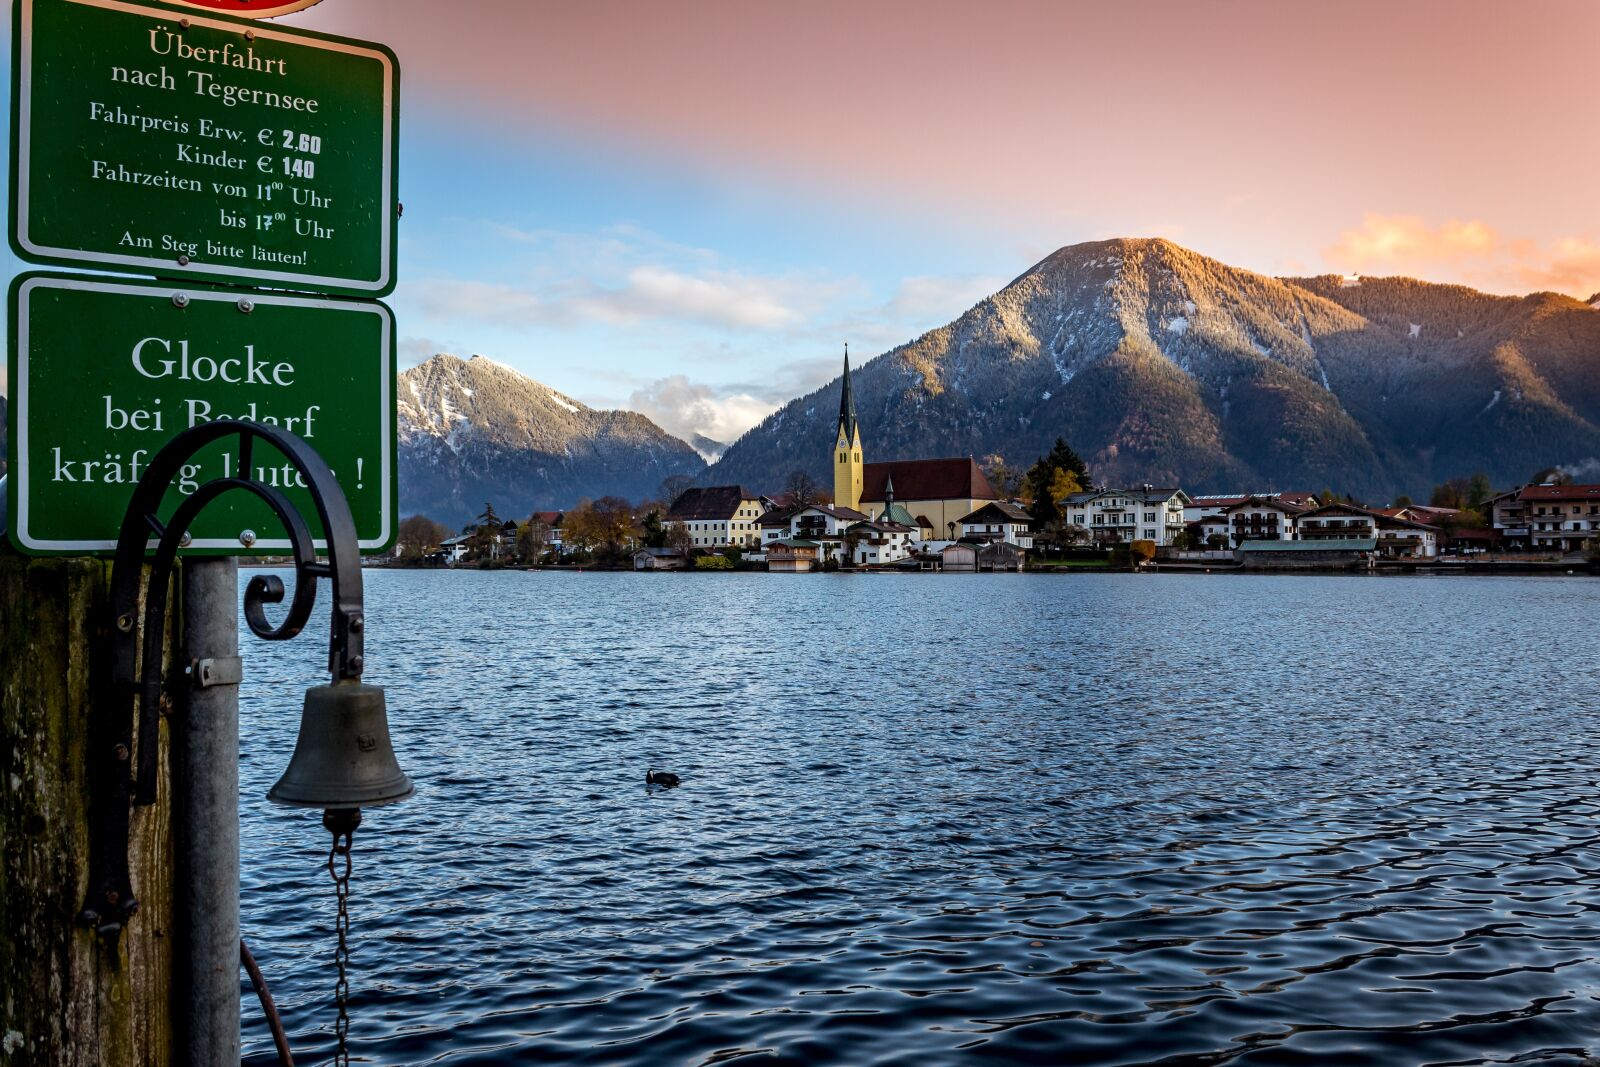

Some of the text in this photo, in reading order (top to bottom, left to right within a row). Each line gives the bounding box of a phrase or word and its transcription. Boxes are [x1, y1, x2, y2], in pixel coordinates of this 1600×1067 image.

[148, 25, 288, 77] Überfahrt
[111, 65, 320, 114] nach Tegernsee
[89, 101, 322, 155] Fahrpreis Erw. € 2,60
[91, 160, 203, 193] Fahrzeiten
[212, 183, 248, 199] von
[291, 187, 333, 209] Uhr
[176, 143, 315, 180] Kinder € 1,40
[118, 230, 308, 266] Am Steg bitte läuten!
[219, 208, 247, 231] bis
[294, 218, 336, 240] Uhr
[131, 336, 296, 388] Glocke
[102, 395, 165, 432] bei
[51, 446, 202, 496] kräfg
